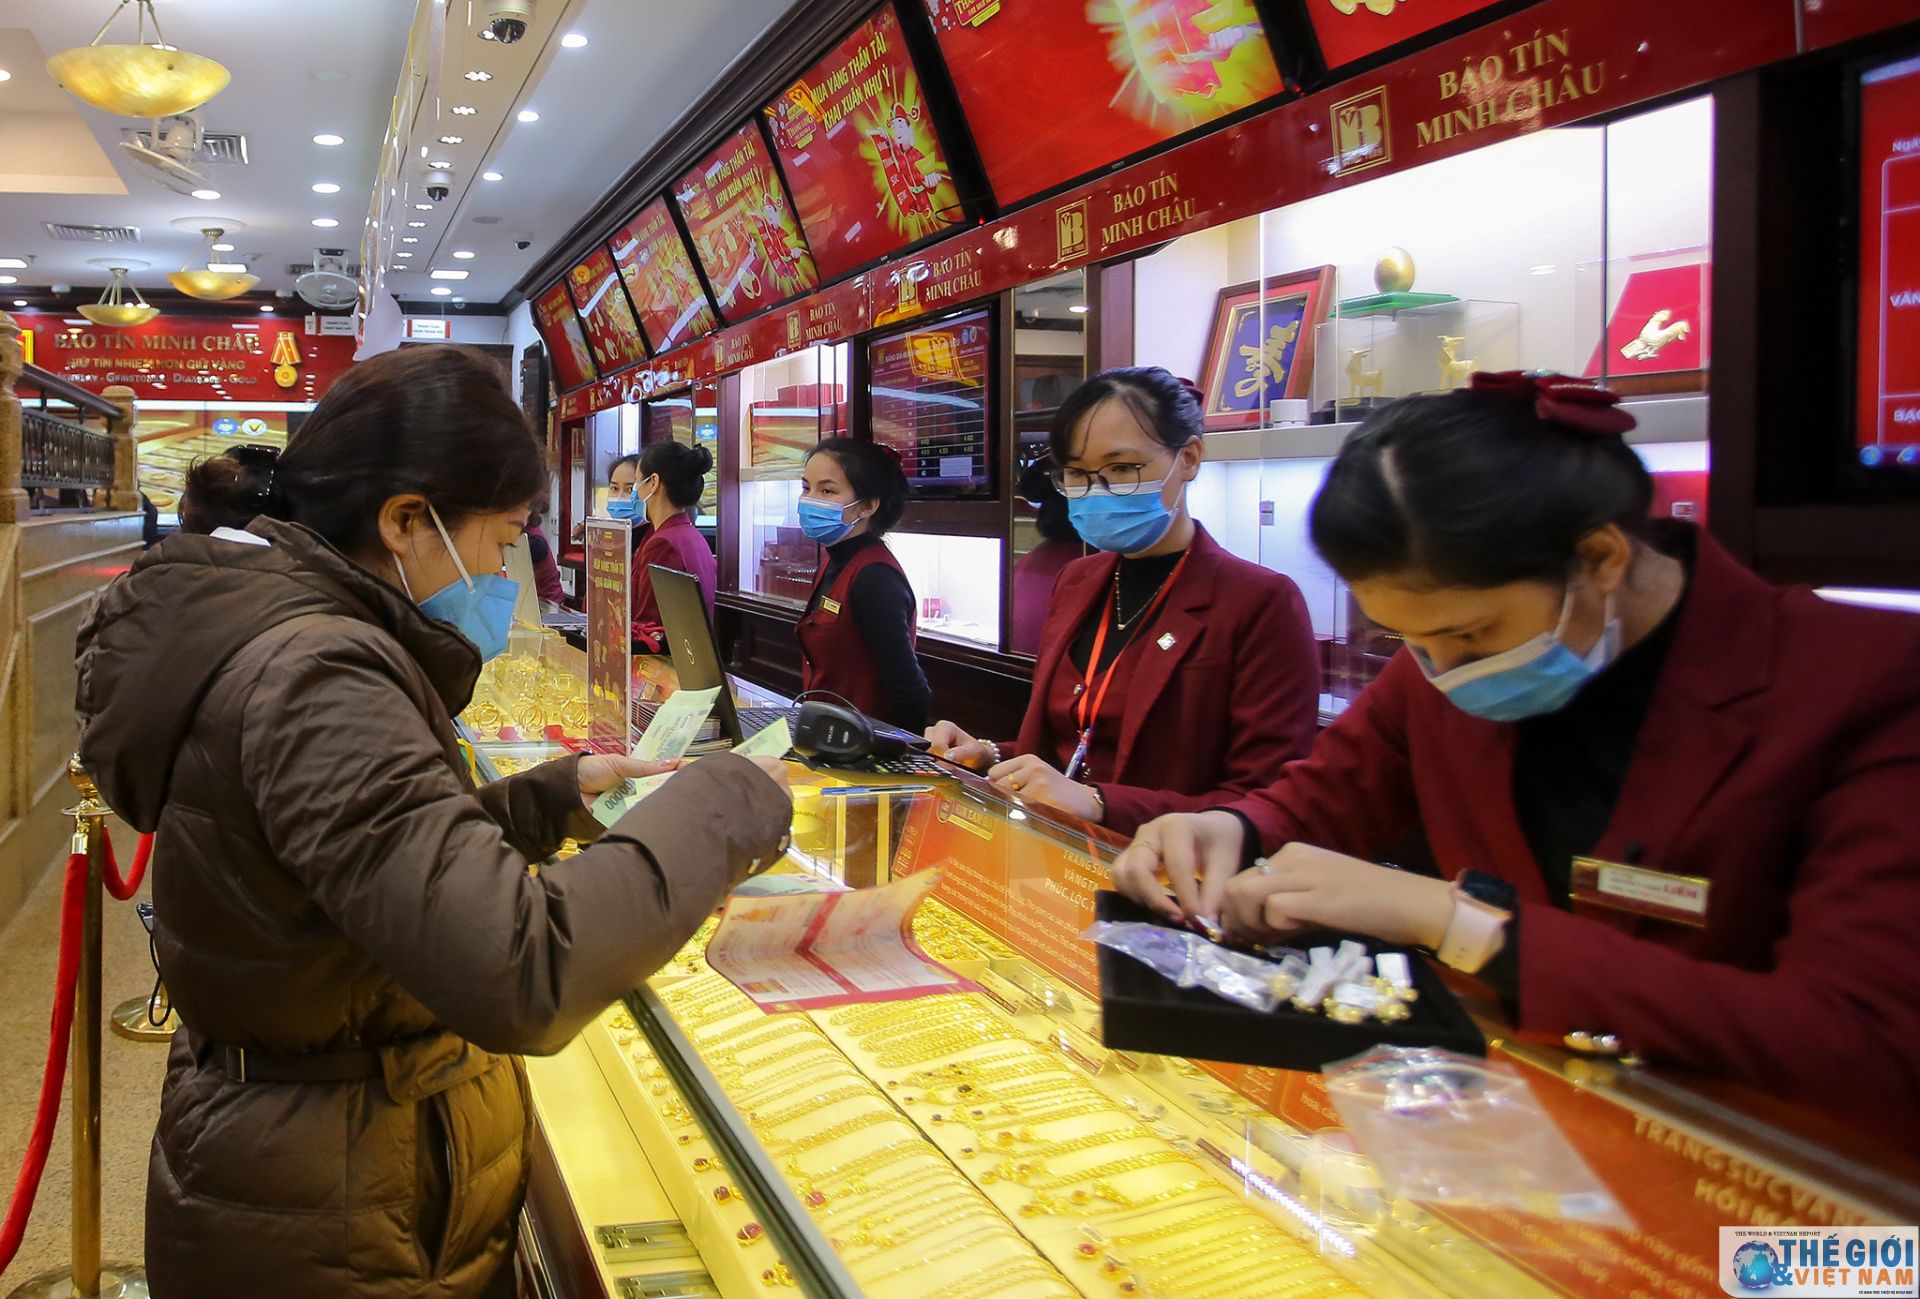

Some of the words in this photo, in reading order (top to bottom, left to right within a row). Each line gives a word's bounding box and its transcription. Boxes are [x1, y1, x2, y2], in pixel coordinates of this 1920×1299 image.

[1438, 56, 1503, 100] BẢO
[1510, 28, 1570, 73] TÍN
[823, 106, 842, 131] KHAI
[1416, 99, 1498, 147] MINH
[1505, 60, 1606, 117] CHÂU
[1113, 184, 1146, 213] BẢO
[1149, 171, 1178, 200] TÍN
[1101, 216, 1143, 246] MINH
[1147, 197, 1195, 231] CHÂU
[954, 247, 972, 269] TÍN
[925, 280, 951, 302] MINH
[953, 268, 981, 293] CHÂU
[101, 331, 135, 349] TÍN
[141, 336, 196, 350] MINH
[805, 323, 823, 340] MINH
